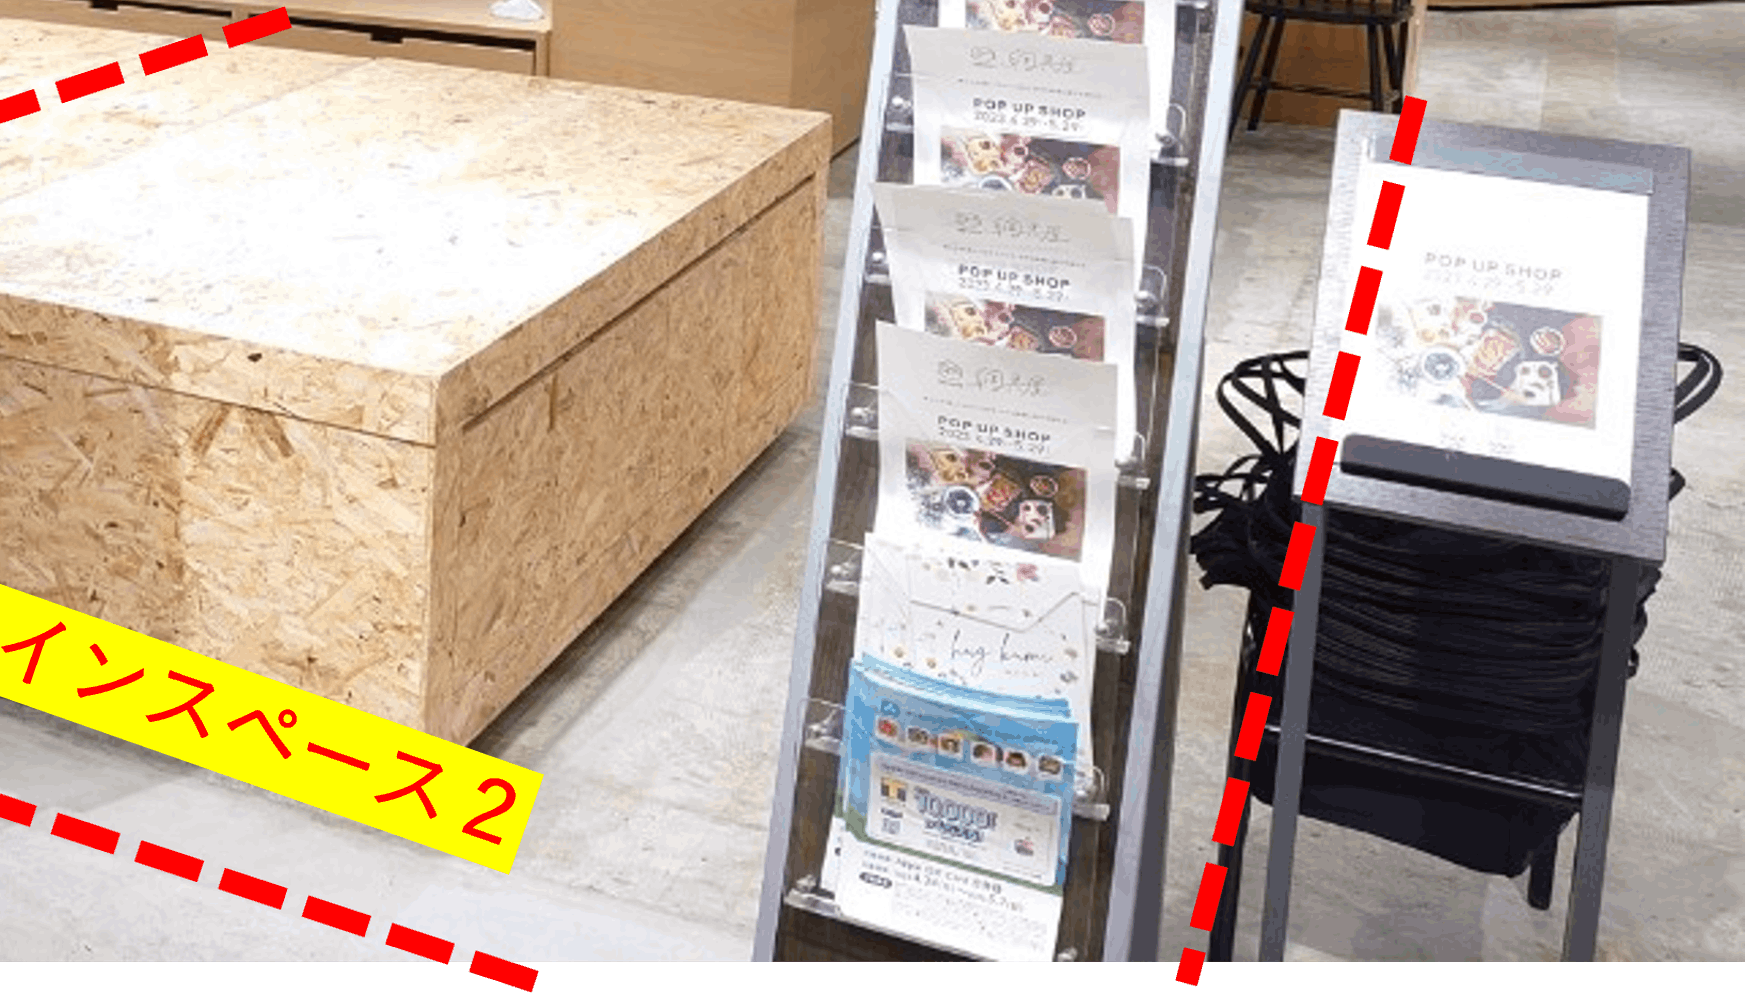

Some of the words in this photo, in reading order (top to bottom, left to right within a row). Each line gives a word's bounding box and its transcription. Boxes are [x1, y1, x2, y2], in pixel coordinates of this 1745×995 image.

[1424, 252, 1466, 268] POP
[1472, 259, 1499, 273] UP
[1505, 263, 1562, 281] SHOP
